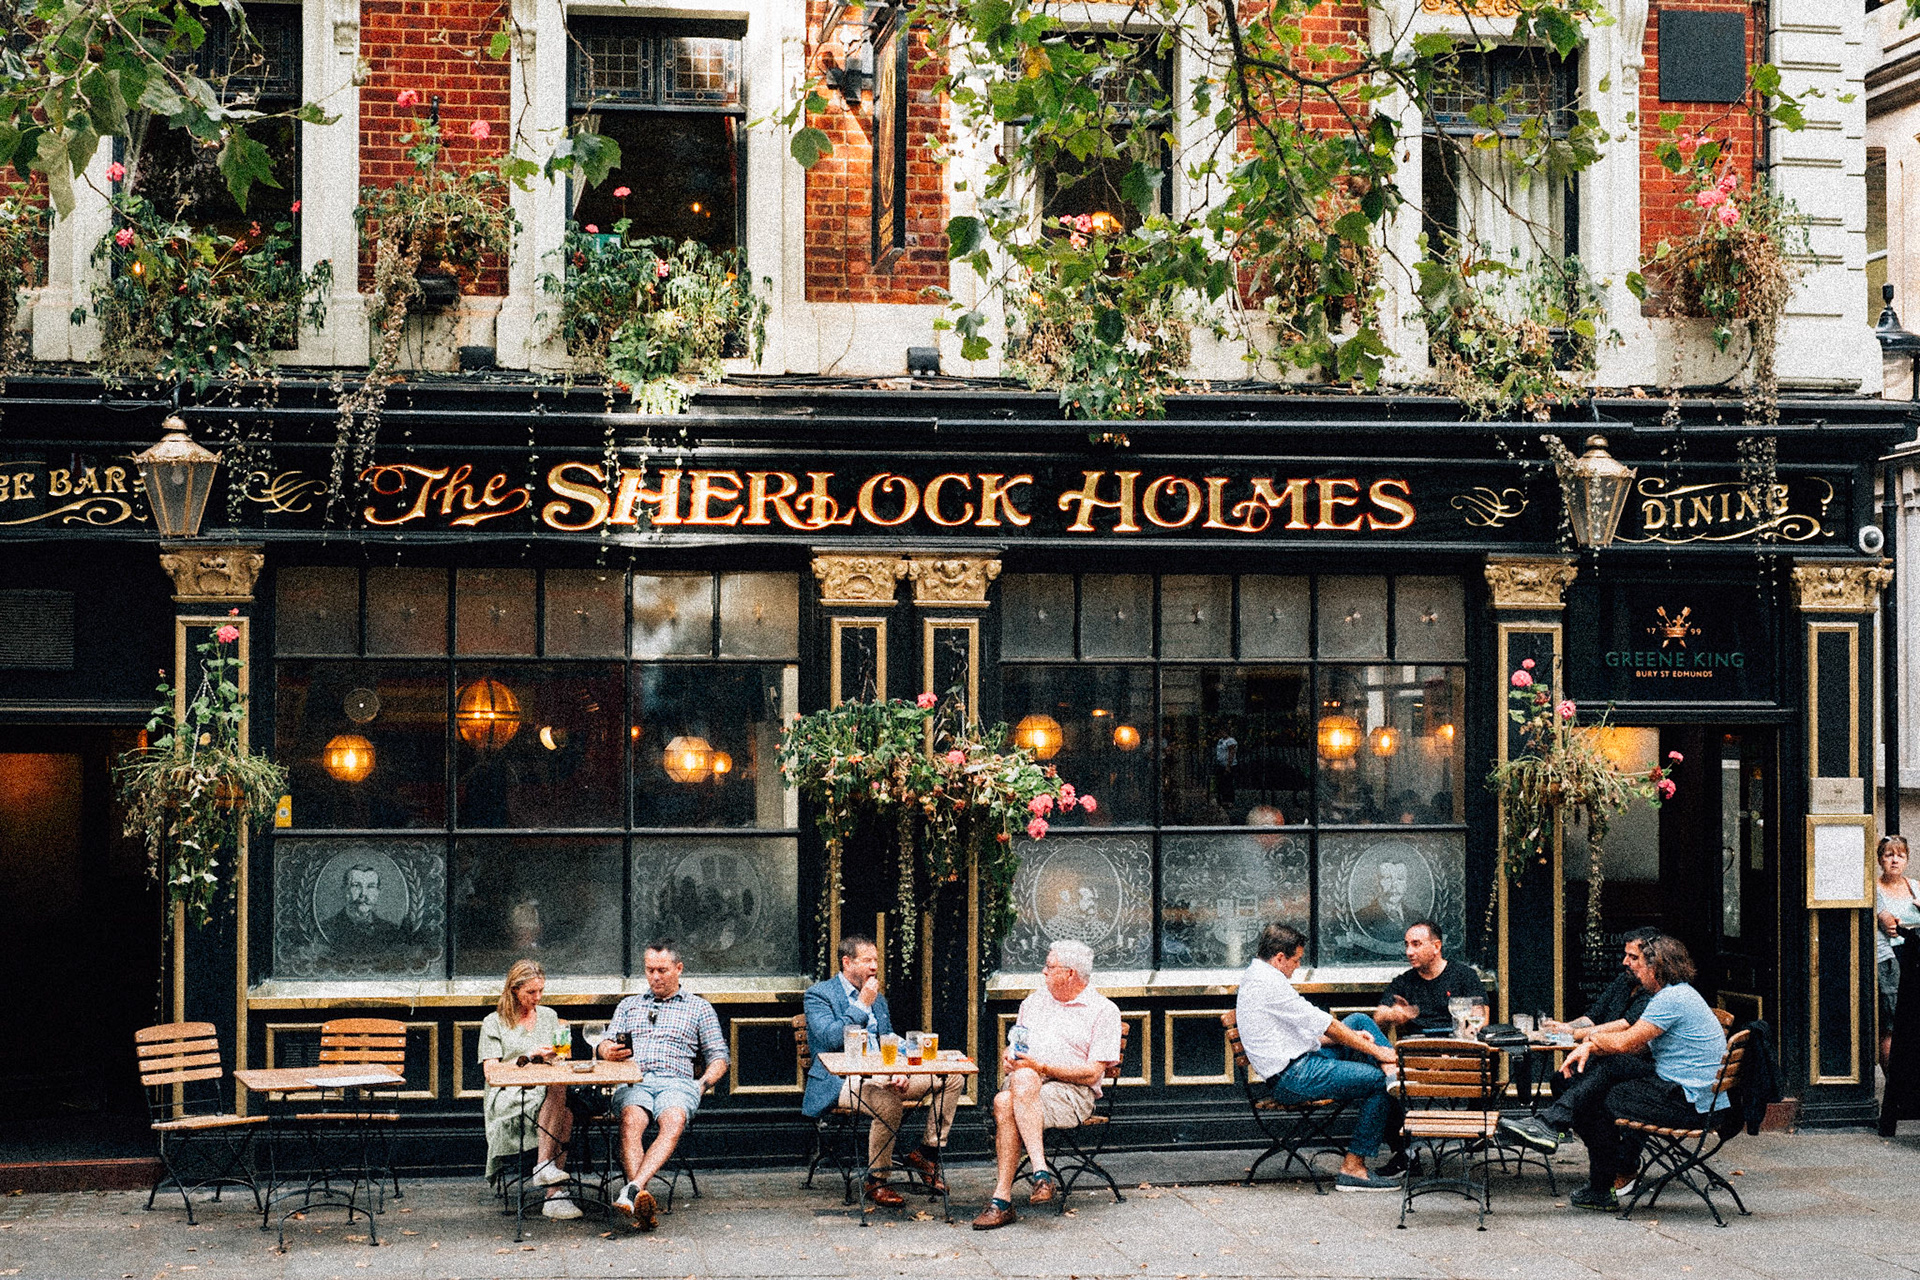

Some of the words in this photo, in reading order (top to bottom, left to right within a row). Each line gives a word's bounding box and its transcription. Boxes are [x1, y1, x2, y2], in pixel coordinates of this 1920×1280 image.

[48, 466, 128, 496] BAR
[359, 464, 530, 526] The
[542, 461, 1034, 531] SHERLOCK
[1058, 470, 1416, 532] HOLMES
[1642, 484, 1789, 529] DINING
[1605, 651, 1685, 668] GREENE
[1694, 651, 1745, 668] KING
[1636, 670, 1657, 678] BURY
[1660, 670, 1670, 678] ST
[1672, 670, 1713, 678] EDMUNDS
